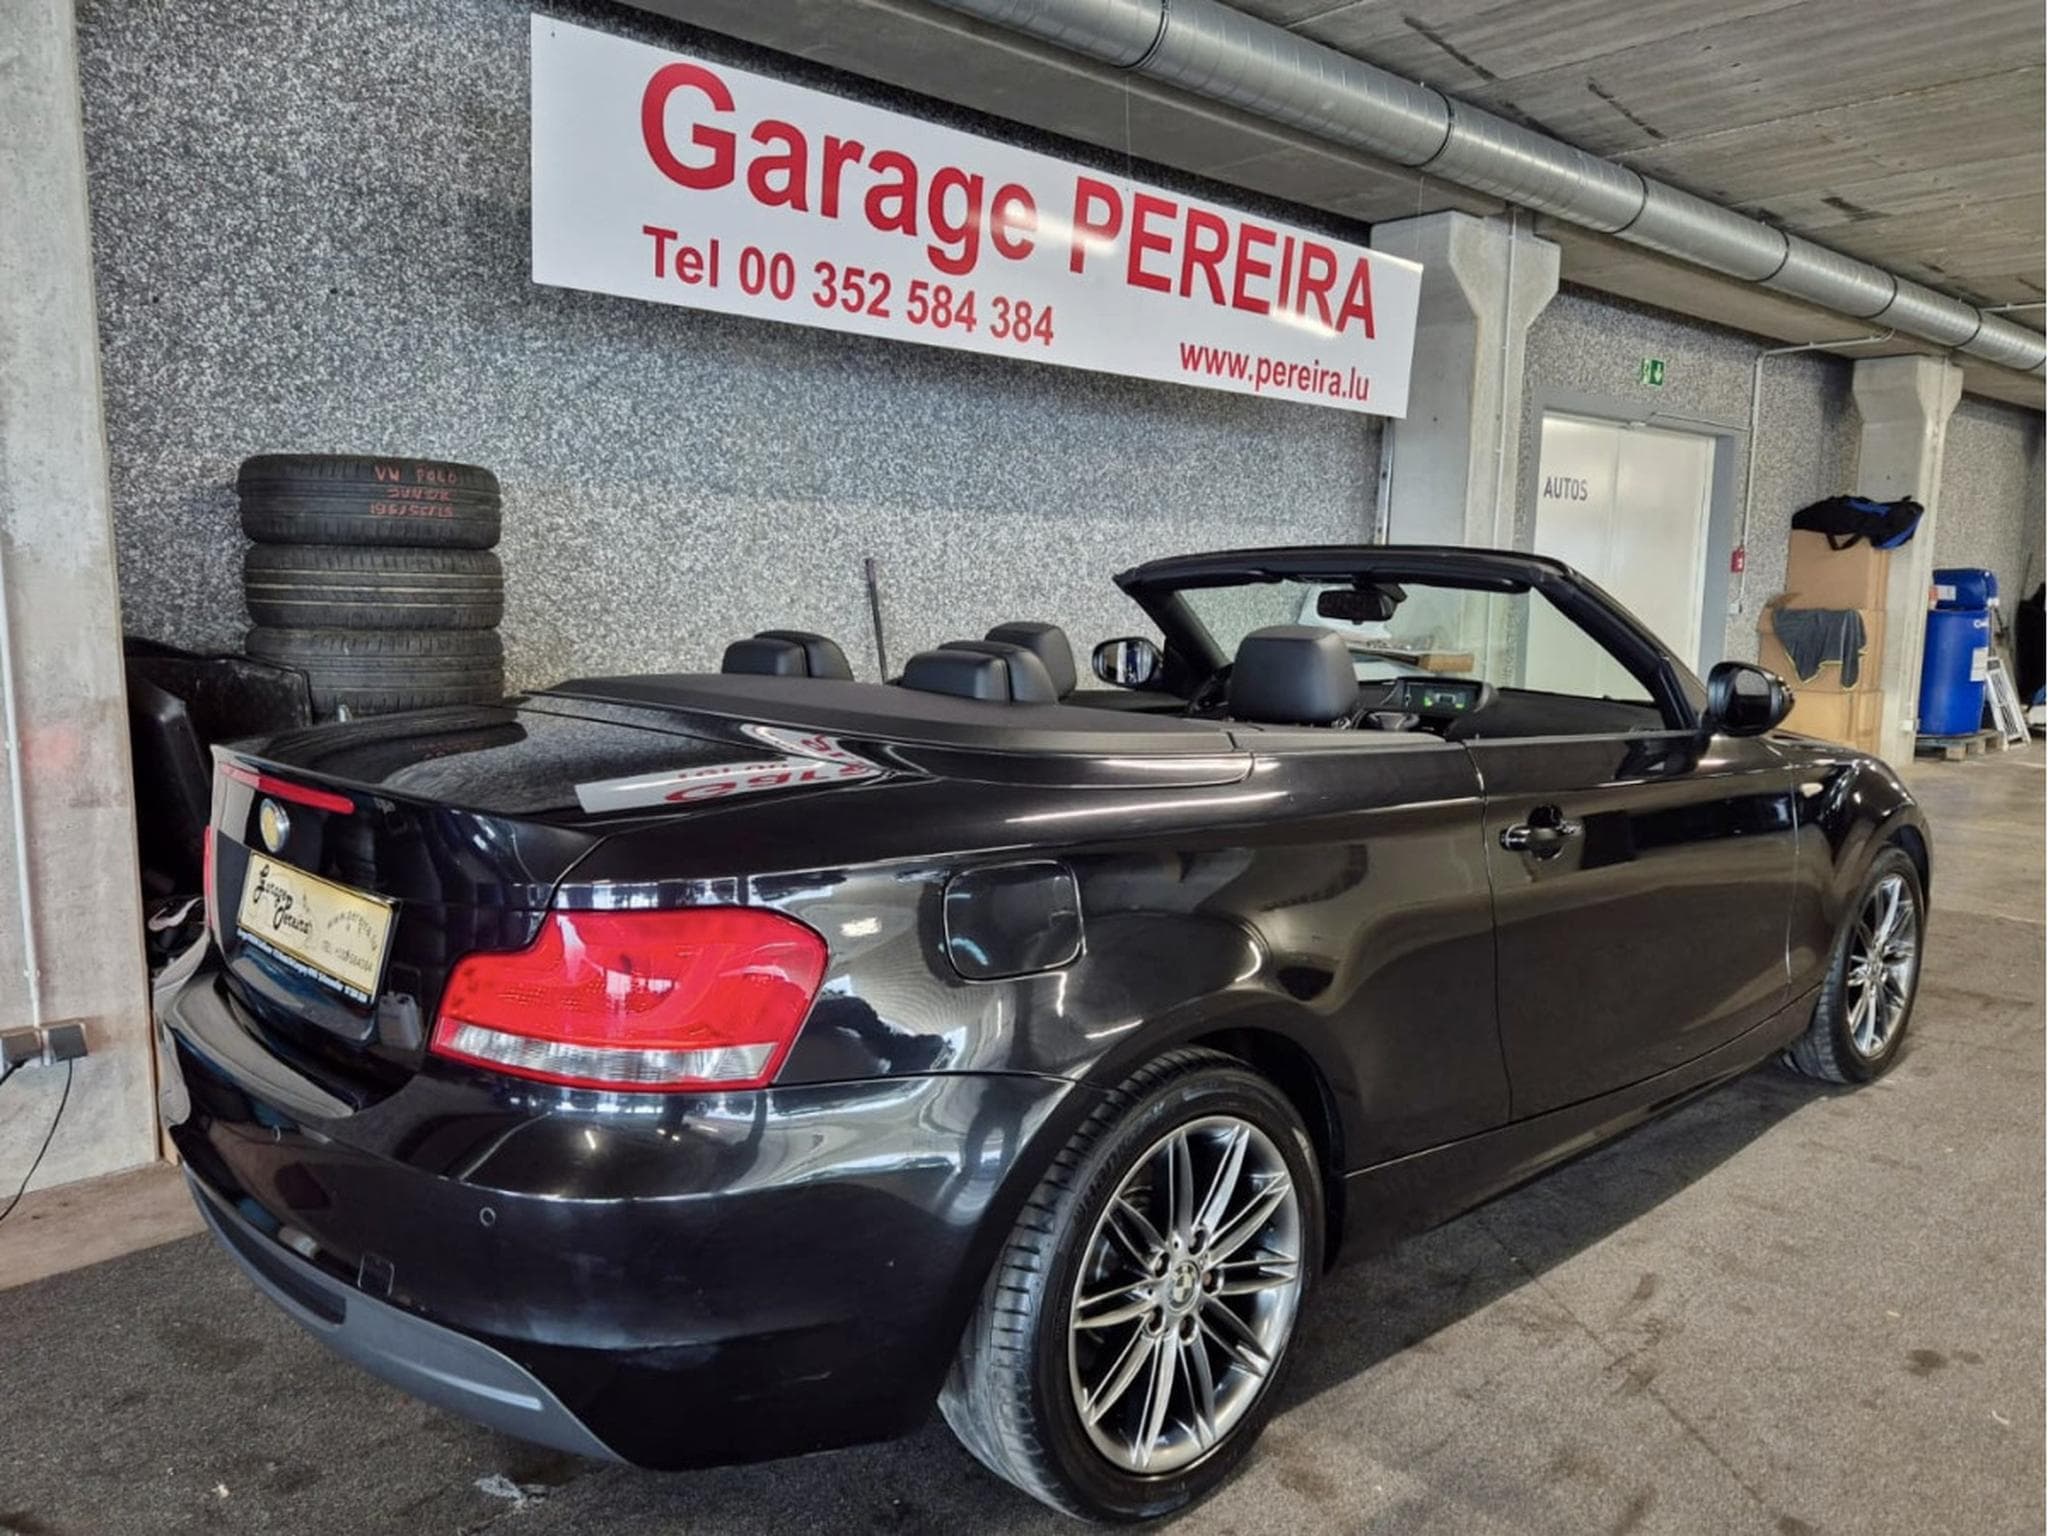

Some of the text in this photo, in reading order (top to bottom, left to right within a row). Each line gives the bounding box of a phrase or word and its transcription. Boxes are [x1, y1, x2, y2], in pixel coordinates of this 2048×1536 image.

[641, 62, 1376, 340] Garage PEREIRA
[643, 225, 1054, 345] Tel 00 352 584 384
[1180, 340, 1370, 402] www.pereira.lu
[374, 463, 458, 485] VW POLO
[1543, 476, 1588, 501] AUTOS
